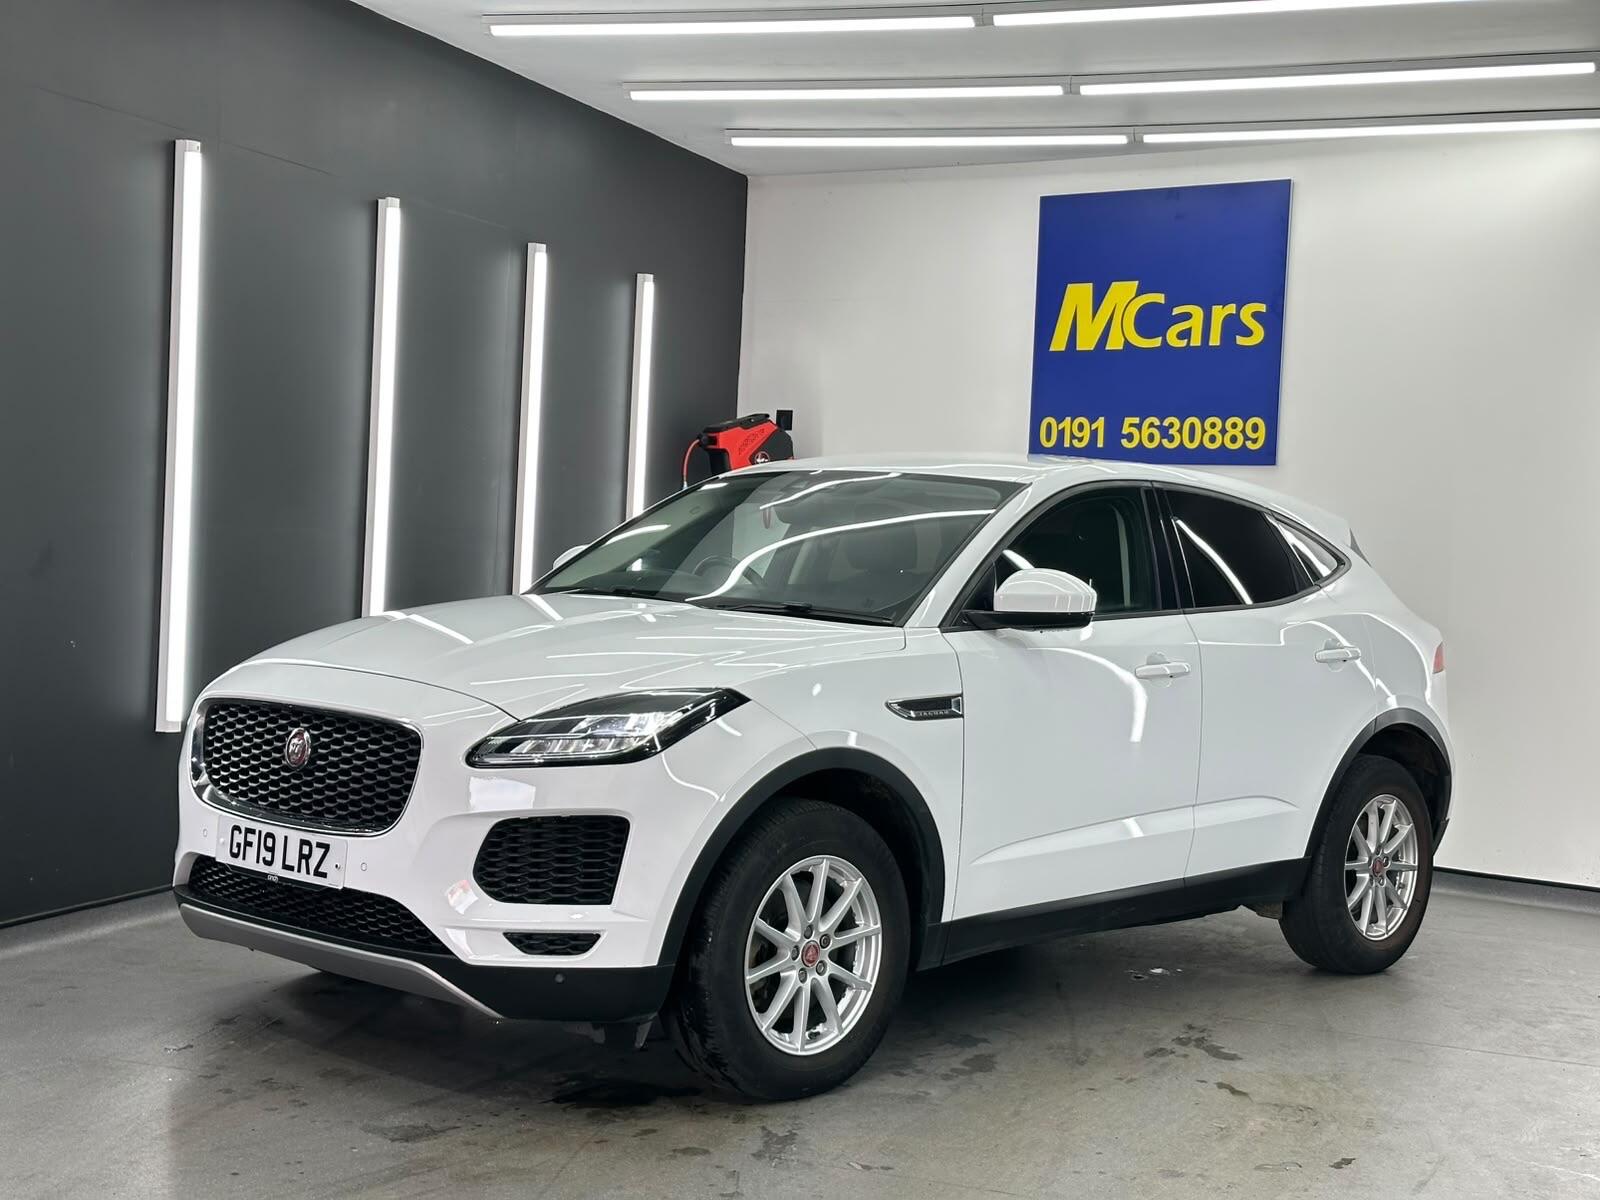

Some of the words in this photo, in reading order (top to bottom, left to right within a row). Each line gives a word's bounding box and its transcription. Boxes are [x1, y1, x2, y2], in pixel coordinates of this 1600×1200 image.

[1049, 280, 1267, 352] MCars
[1039, 416, 1104, 448] 0191
[1121, 416, 1266, 449] 5630889
[229, 824, 276, 866] GF19
[281, 835, 330, 879] LRZ
